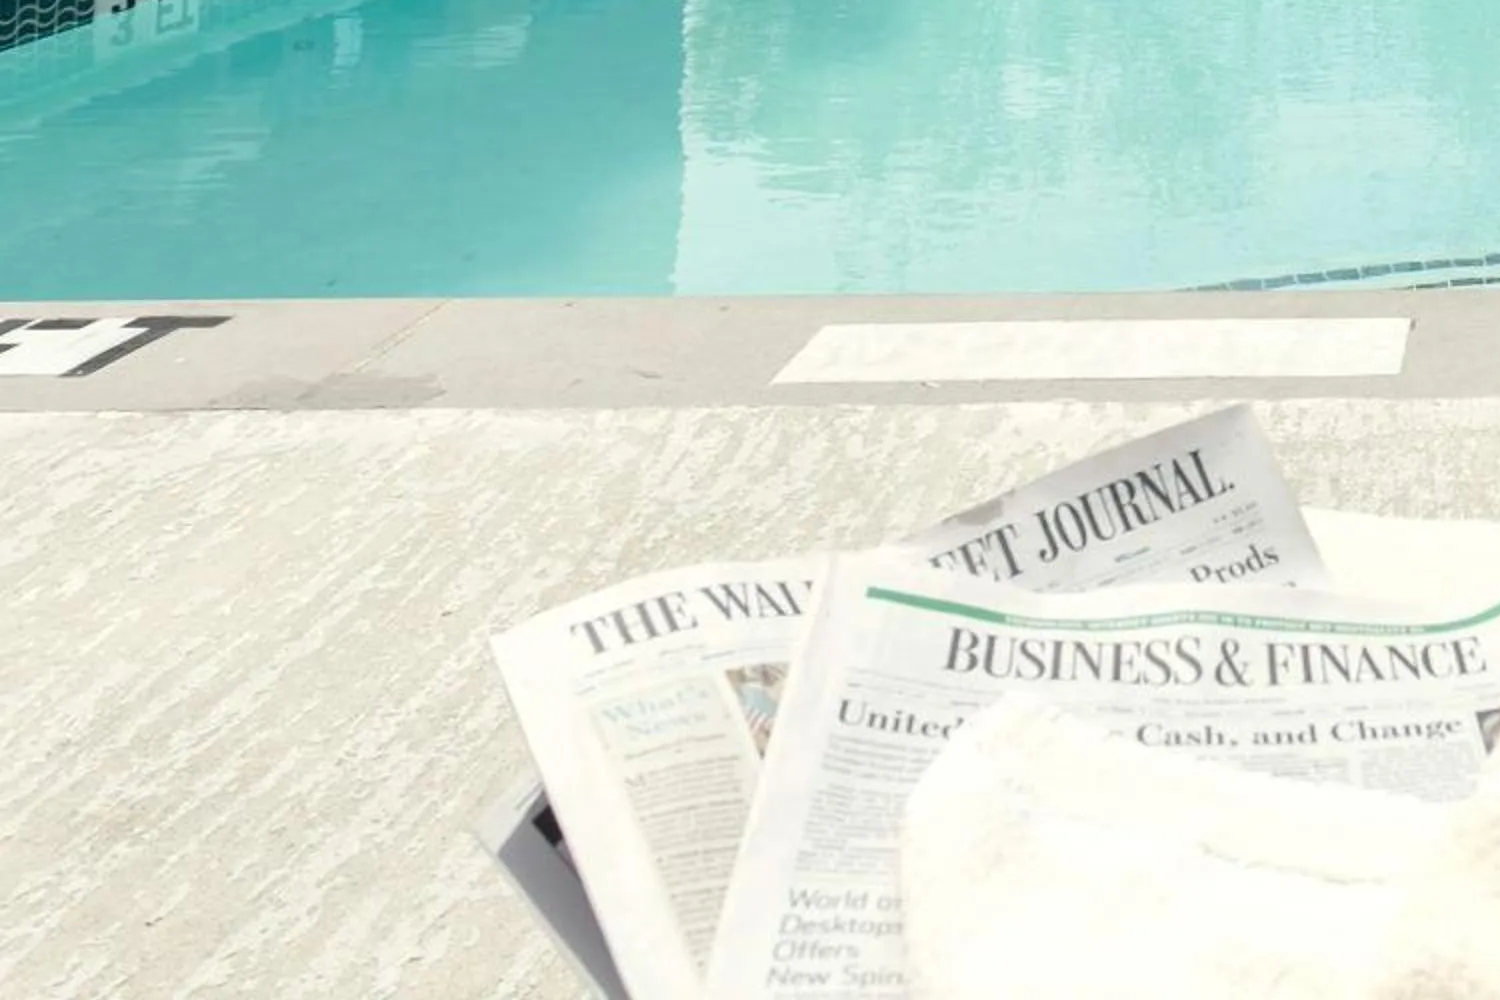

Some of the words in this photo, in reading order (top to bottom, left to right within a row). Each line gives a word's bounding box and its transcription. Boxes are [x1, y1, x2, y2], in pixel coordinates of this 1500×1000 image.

[1032, 449, 1236, 564] JOURNAL.
[1189, 543, 1281, 584] Prods
[569, 590, 698, 655] THE
[700, 579, 814, 621] WAL
[945, 626, 1204, 687] BUSINESS
[1214, 637, 1252, 687] &
[1265, 635, 1488, 687] FINANCE
[1136, 722, 1240, 749] Cash,
[1252, 723, 1318, 745] and
[1330, 718, 1464, 744] Change
[788, 887, 869, 910] World
[772, 939, 861, 962] Offers
[766, 965, 832, 988] New
